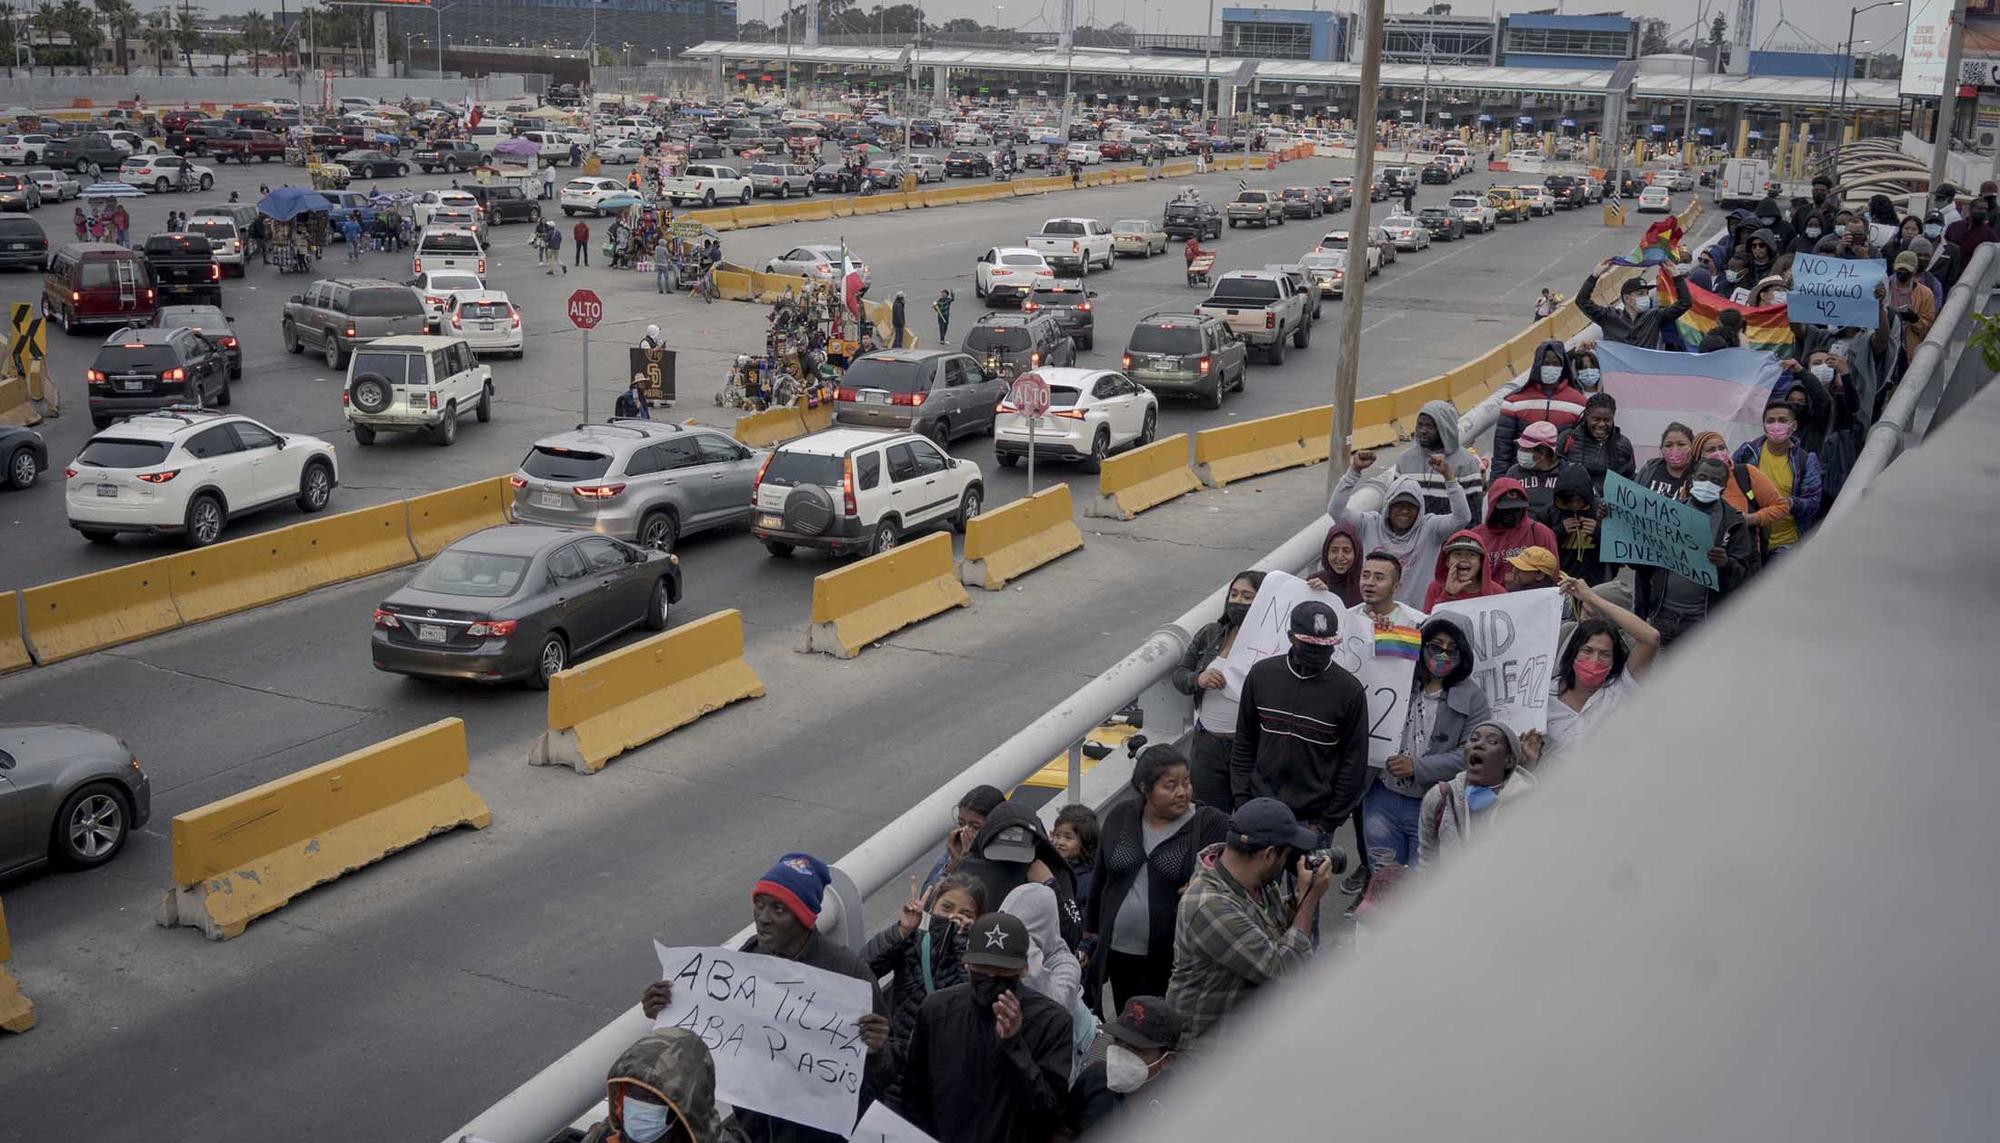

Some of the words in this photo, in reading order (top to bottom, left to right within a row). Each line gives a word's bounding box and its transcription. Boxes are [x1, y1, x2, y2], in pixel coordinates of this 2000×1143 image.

[1799, 258, 1828, 275] NO
[1836, 263, 1861, 278] AL
[1798, 279, 1863, 299] ARTÍCULO
[569, 301, 601, 318] ALTO
[1816, 300, 1840, 318] 42
[1014, 384, 1049, 407] ALTO
[1616, 484, 1637, 510] NO
[1644, 498, 1681, 528] MÁS
[1609, 506, 1700, 550] FRONTERAS
[1632, 527, 1667, 551] PARA
[1673, 548, 1689, 563] LA
[1614, 540, 1713, 587] DIVERSIDAD
[673, 952, 757, 1008] ABA
[674, 1004, 745, 1057] ABA
